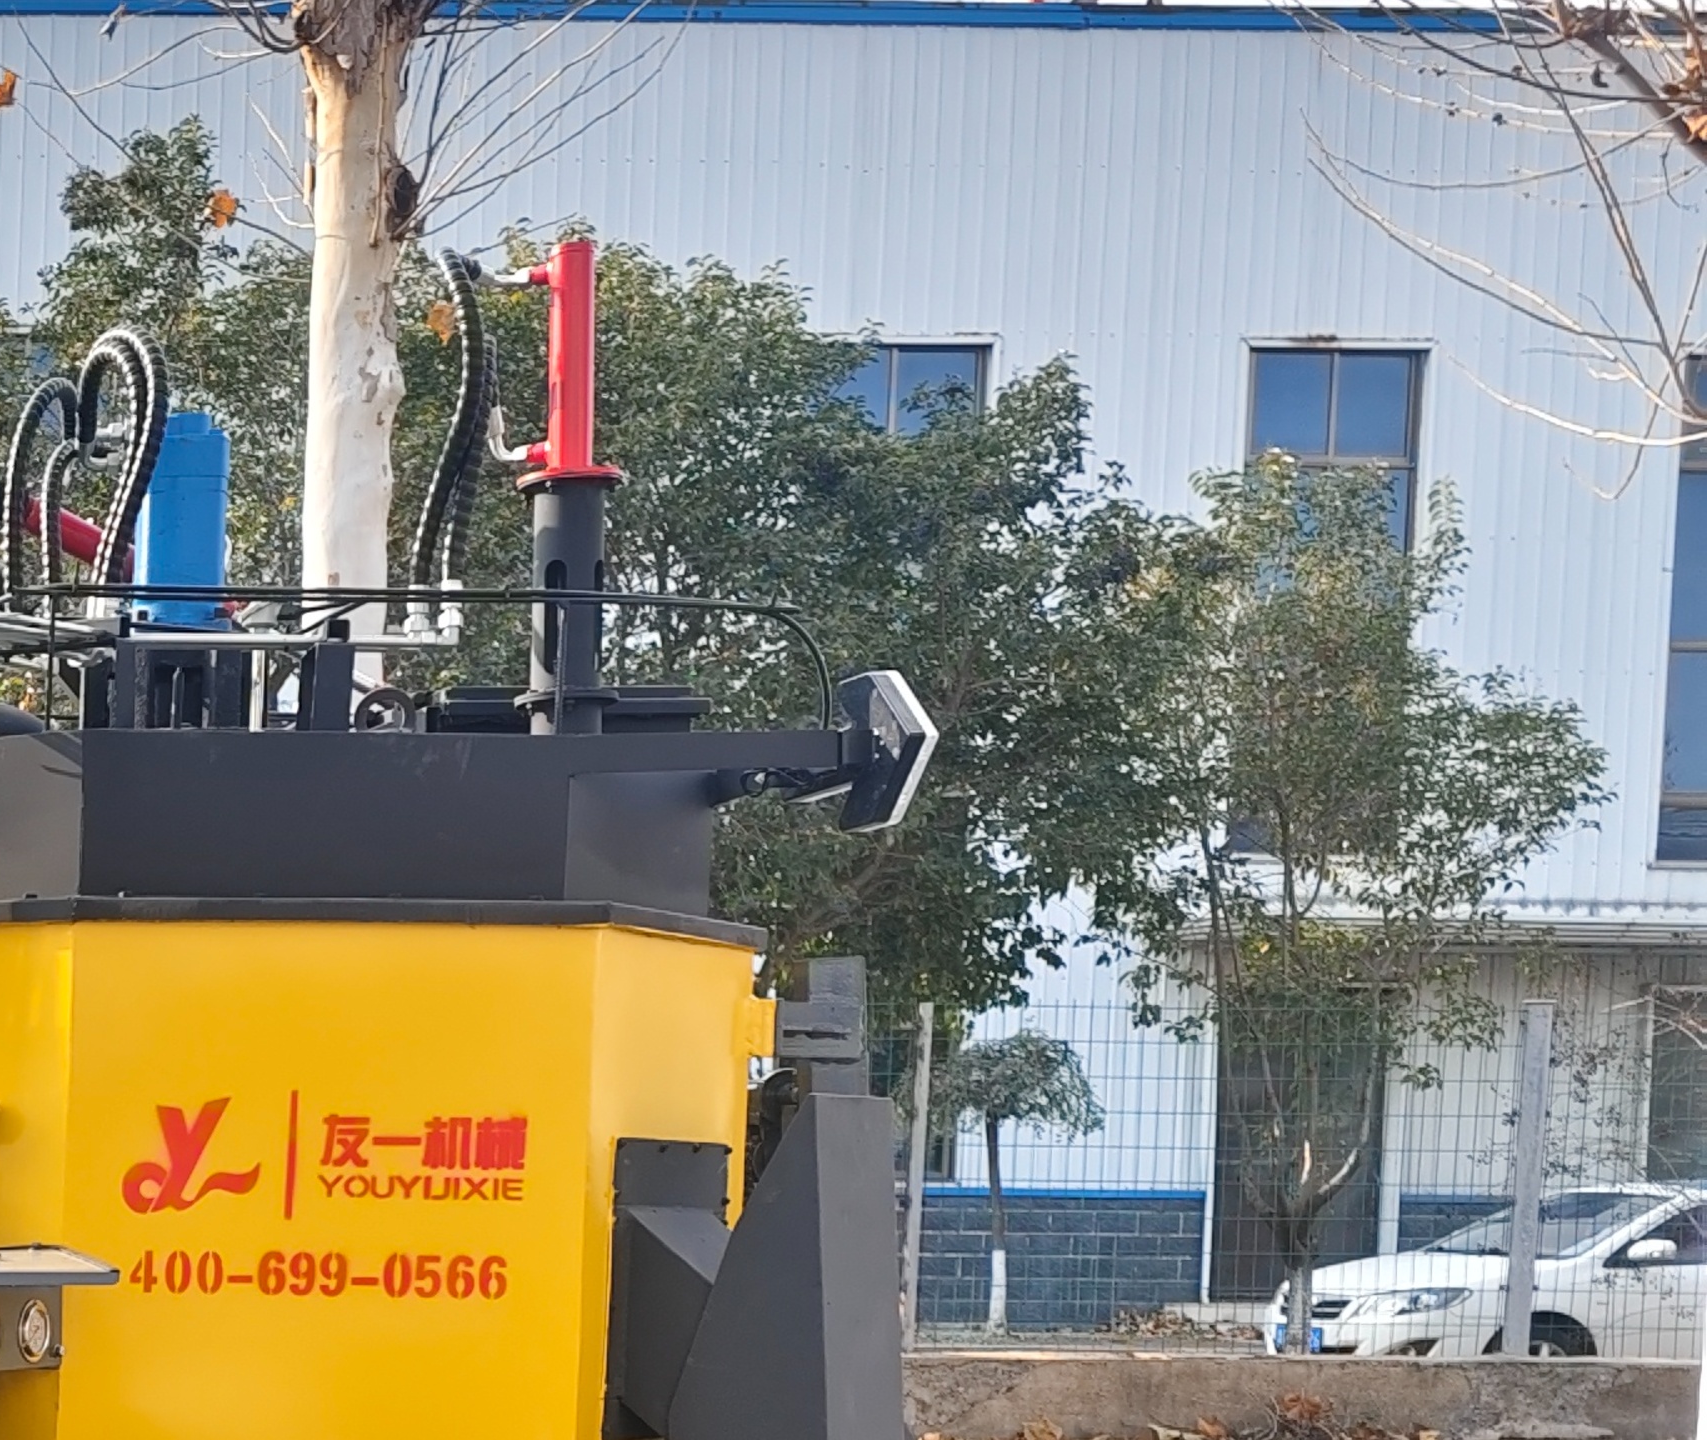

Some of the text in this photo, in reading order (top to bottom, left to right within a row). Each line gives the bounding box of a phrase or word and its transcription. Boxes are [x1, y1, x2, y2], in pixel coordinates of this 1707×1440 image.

[319, 1113, 528, 1171] 友一机械
[318, 1174, 524, 1201] YOUYIJIXIE
[129, 1250, 507, 1299] 400-699-0566
